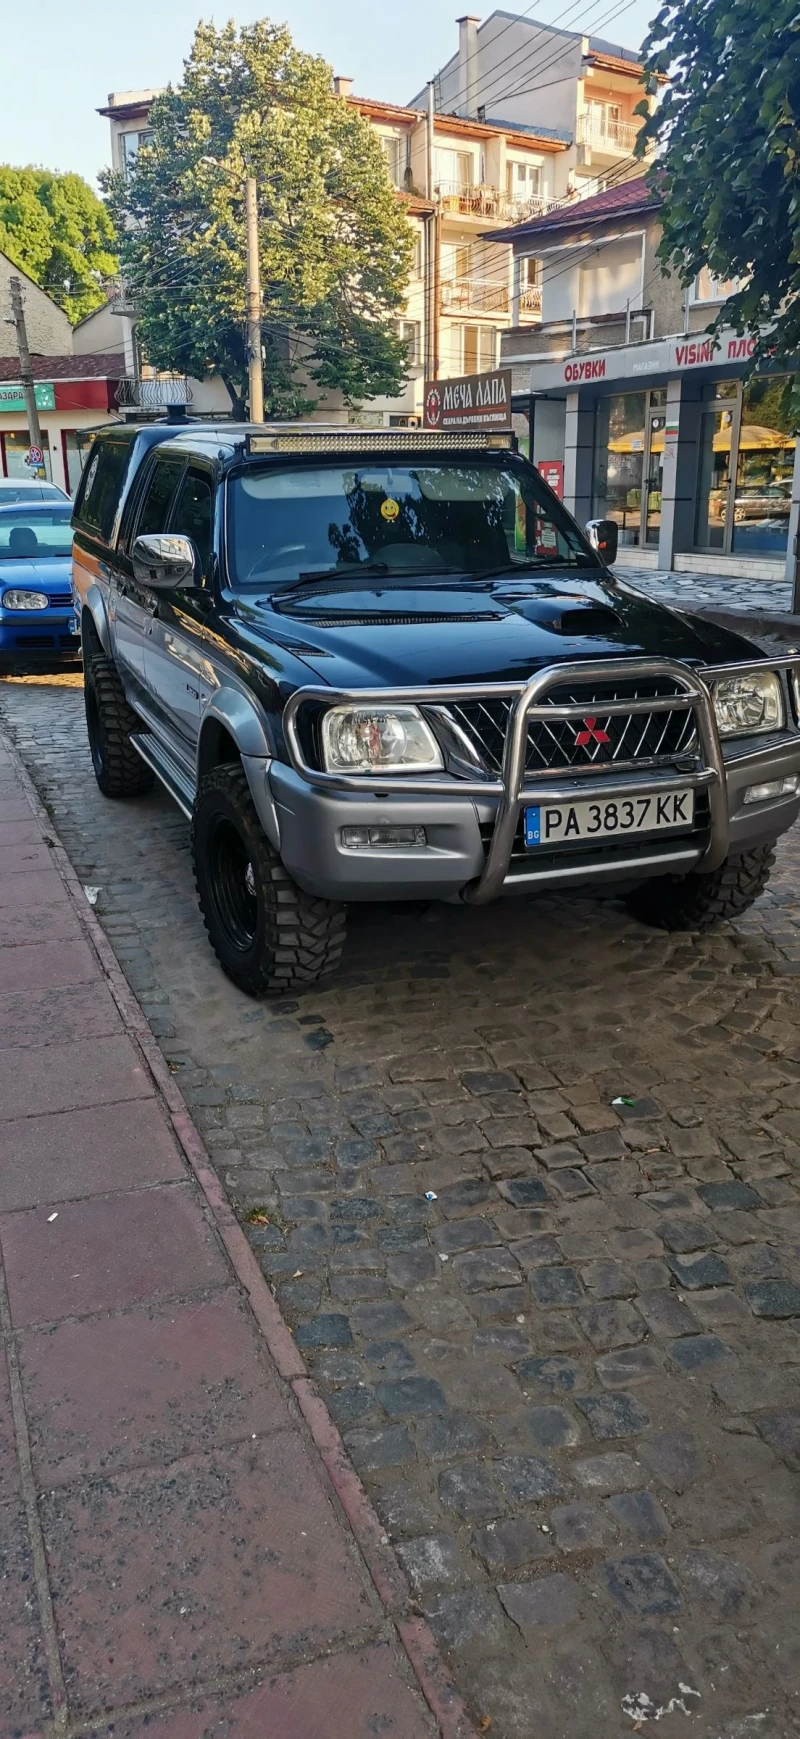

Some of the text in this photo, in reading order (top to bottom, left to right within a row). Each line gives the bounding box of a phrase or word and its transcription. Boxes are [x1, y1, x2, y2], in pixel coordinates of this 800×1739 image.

[564, 359, 606, 382] ОБУВКИ
[632, 360, 660, 372] МАГАЗИН
[443, 377, 507, 411] МЕЧА ЛАПА
[545, 793, 689, 838] PA 3837 KK
[527, 830, 539, 840] BG
